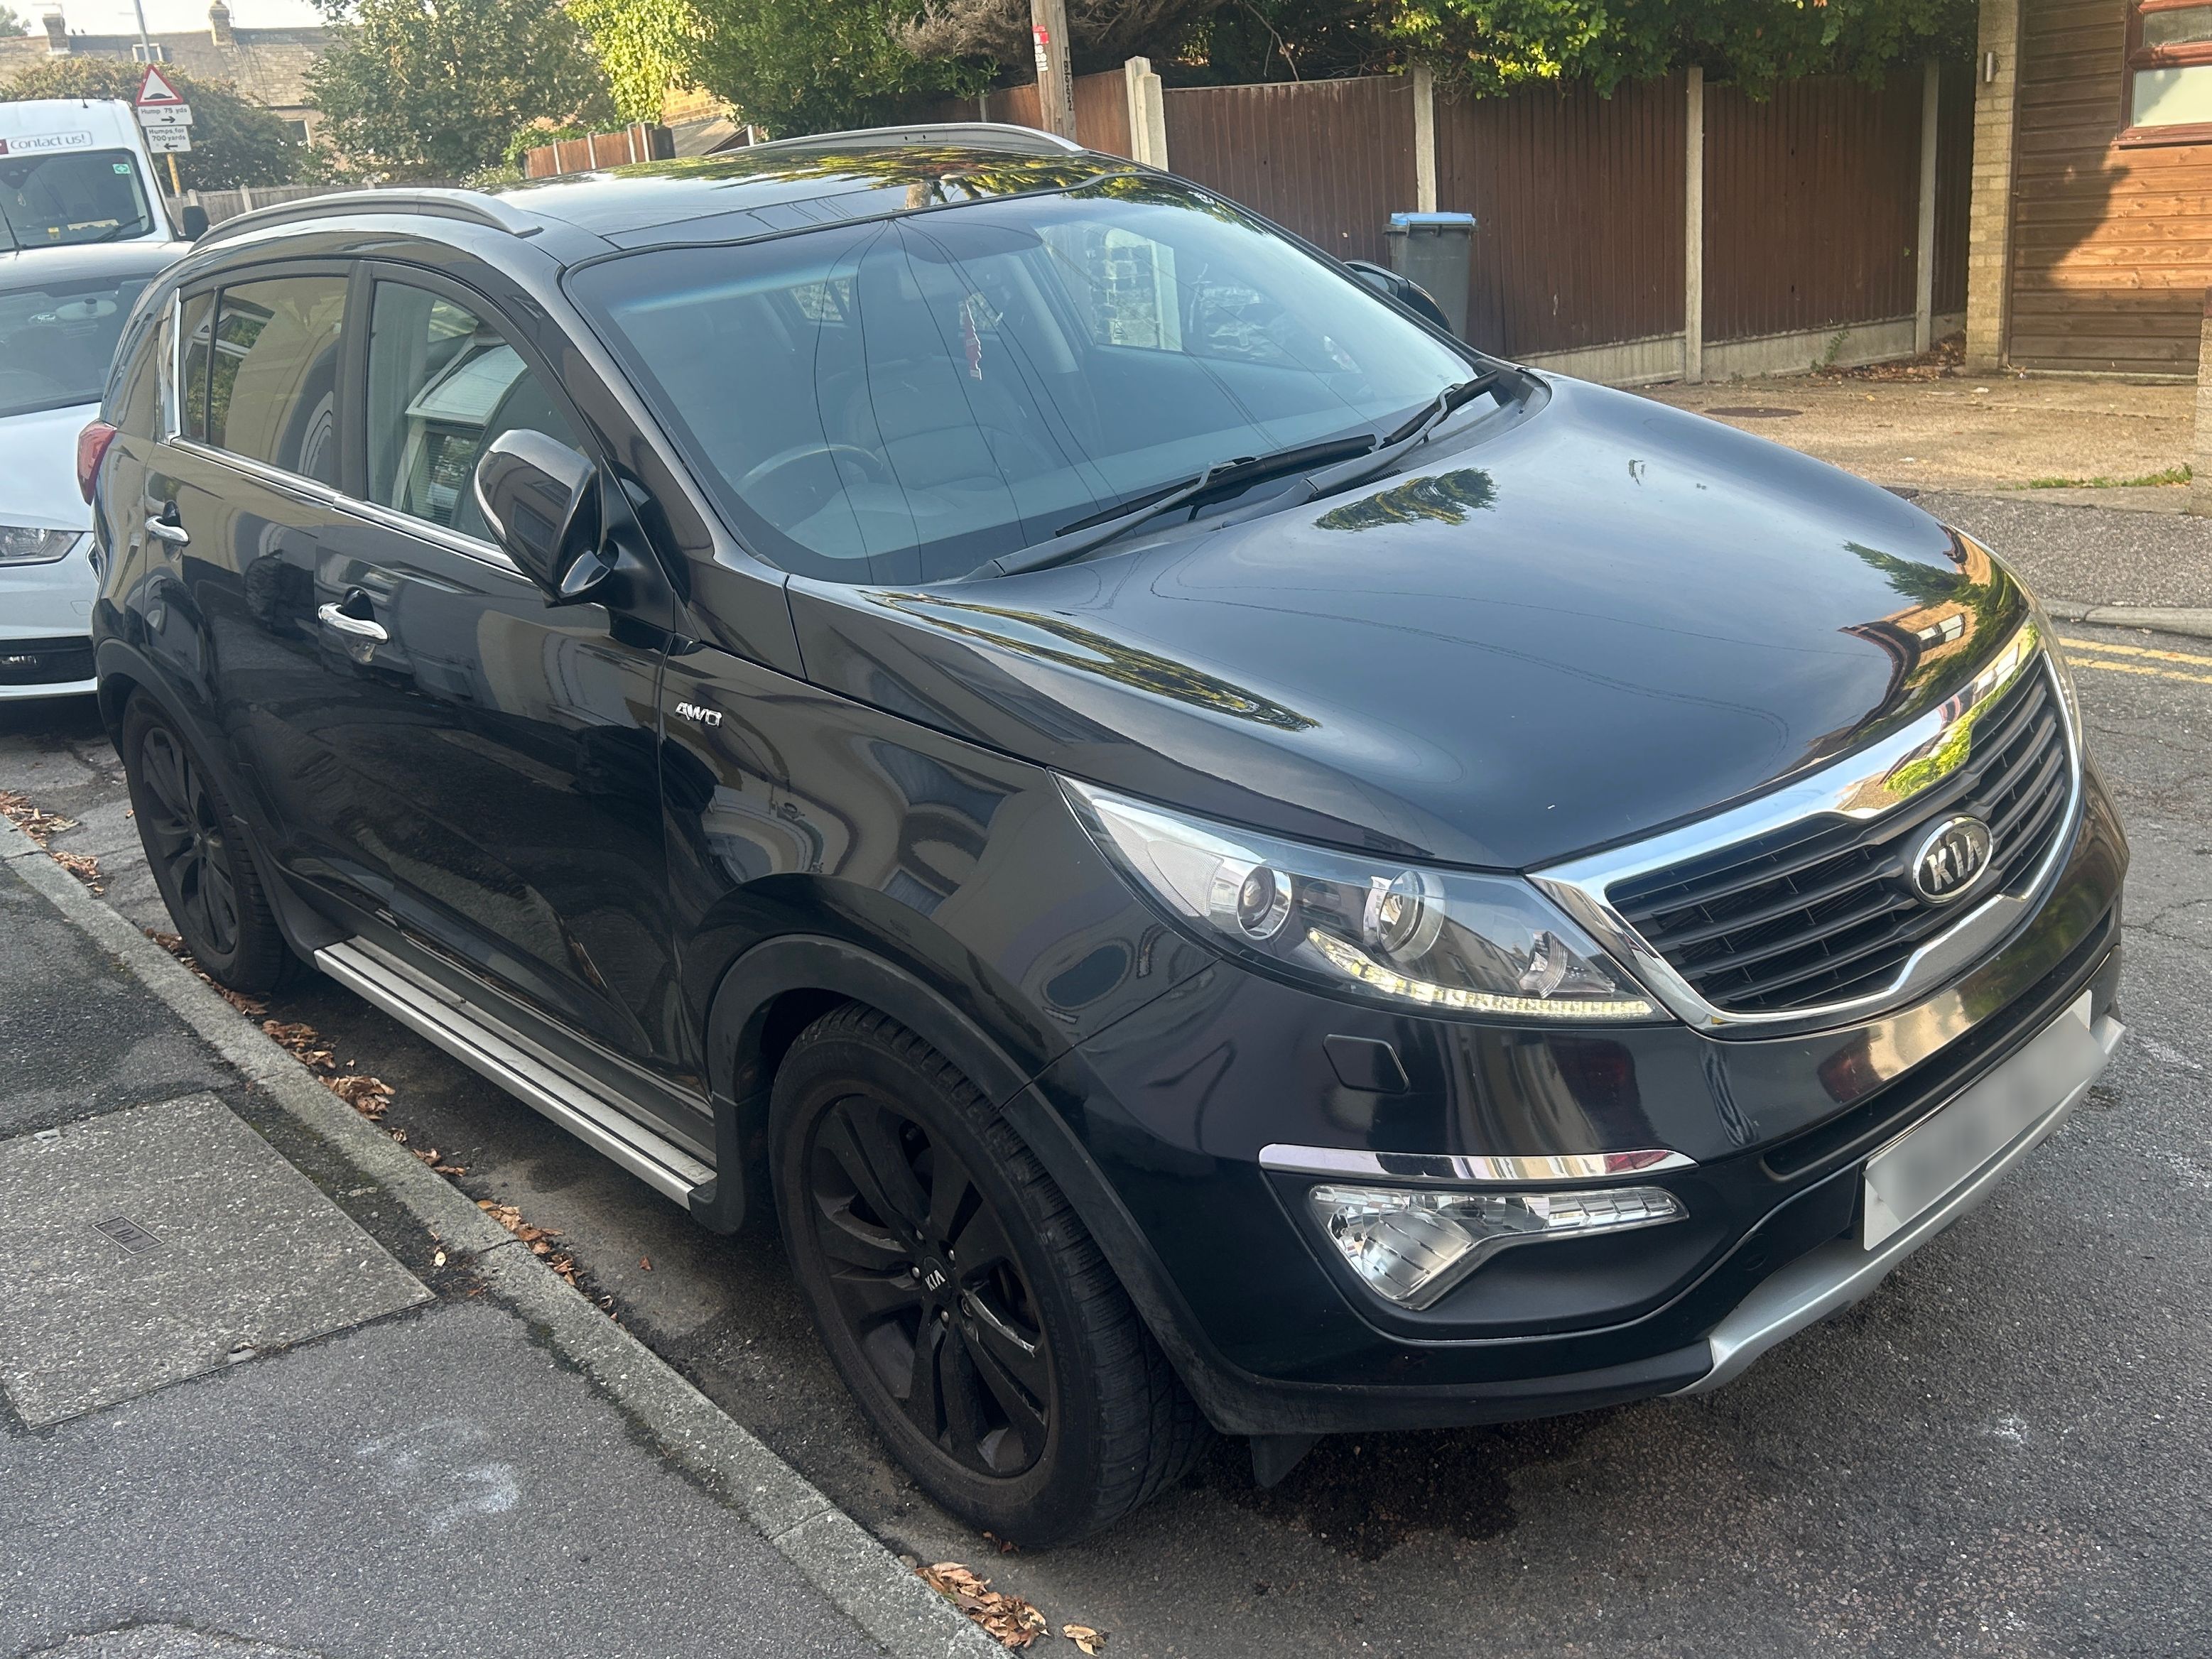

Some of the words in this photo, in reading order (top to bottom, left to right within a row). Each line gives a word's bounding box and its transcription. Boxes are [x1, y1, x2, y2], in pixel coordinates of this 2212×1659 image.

[65, 134, 86, 145] us!
[1926, 831, 1984, 892] KIA
[924, 1270, 945, 1291] KIA
